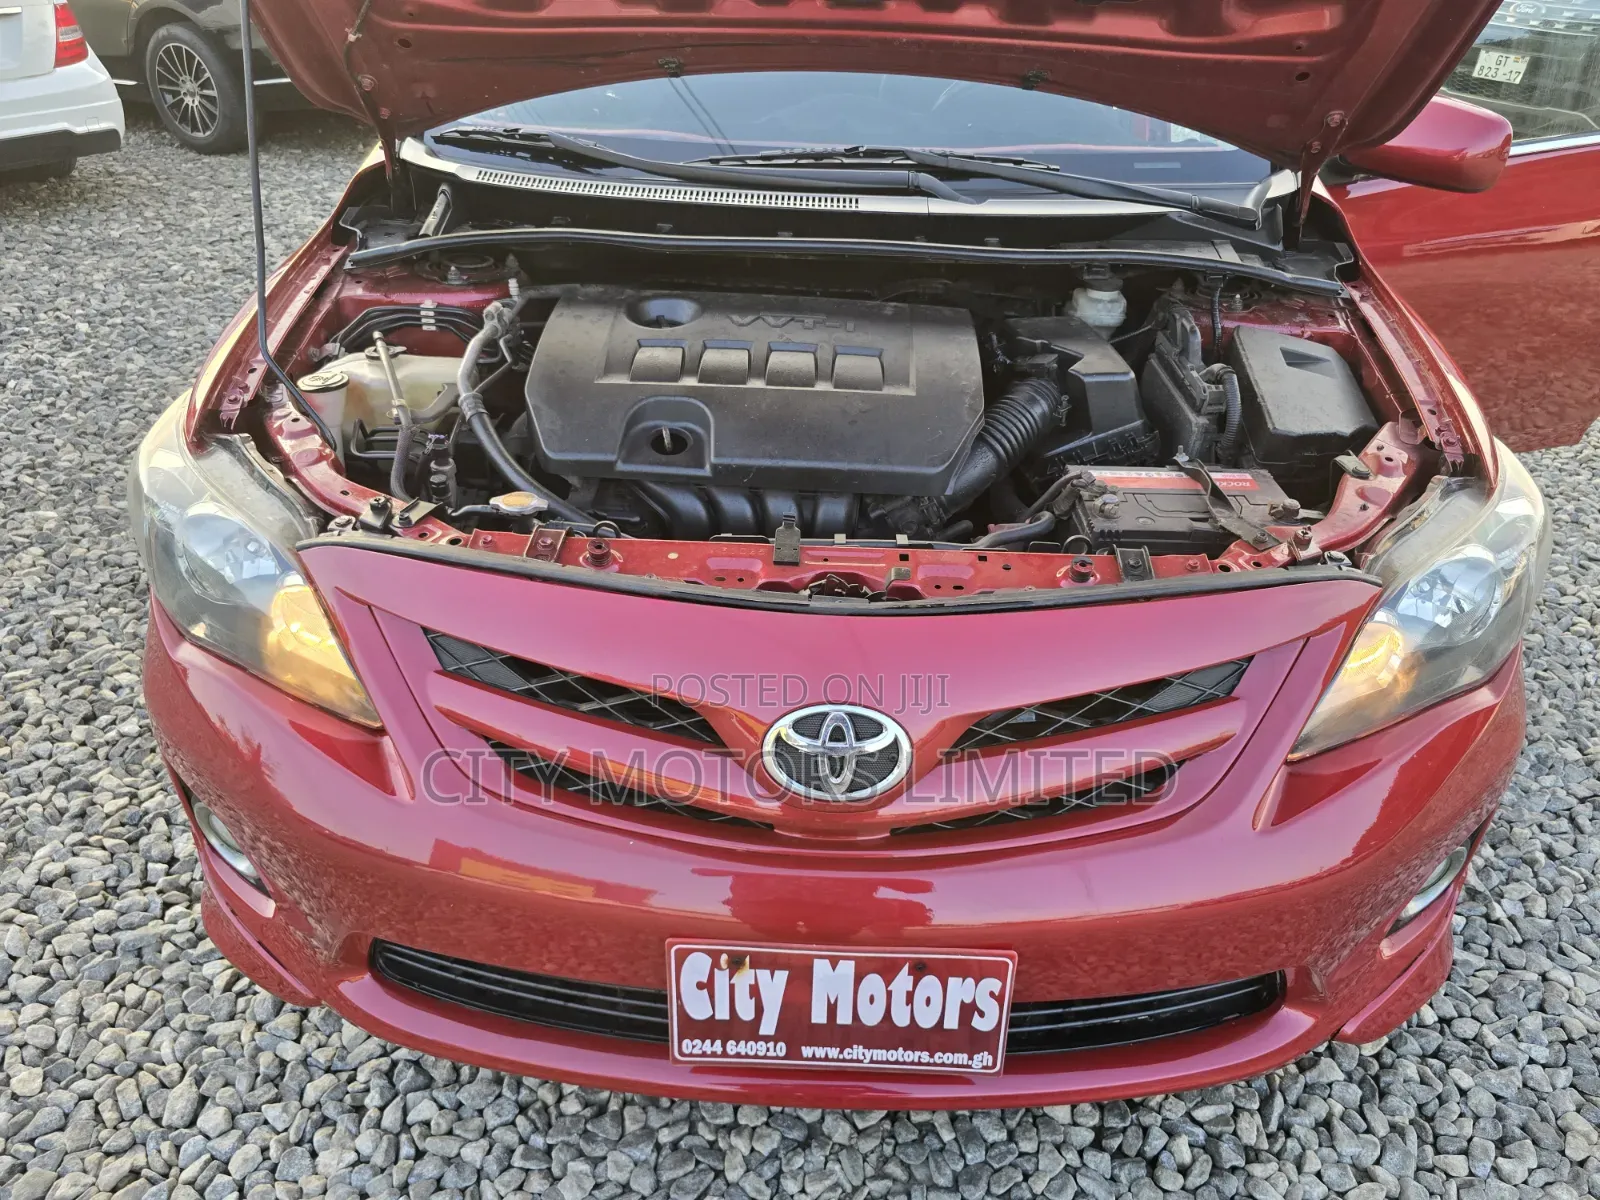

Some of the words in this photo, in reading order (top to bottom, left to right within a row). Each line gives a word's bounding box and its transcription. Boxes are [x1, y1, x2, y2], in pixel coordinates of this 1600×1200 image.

[1516, 3, 1537, 14] Ford
[1495, 54, 1511, 67] GT
[680, 951, 790, 1036] City
[811, 957, 1003, 1032] Motors
[682, 1038, 723, 1055] 0244
[726, 1039, 787, 1057] 640910
[801, 1044, 994, 1069] www.citymotors.com.gh
